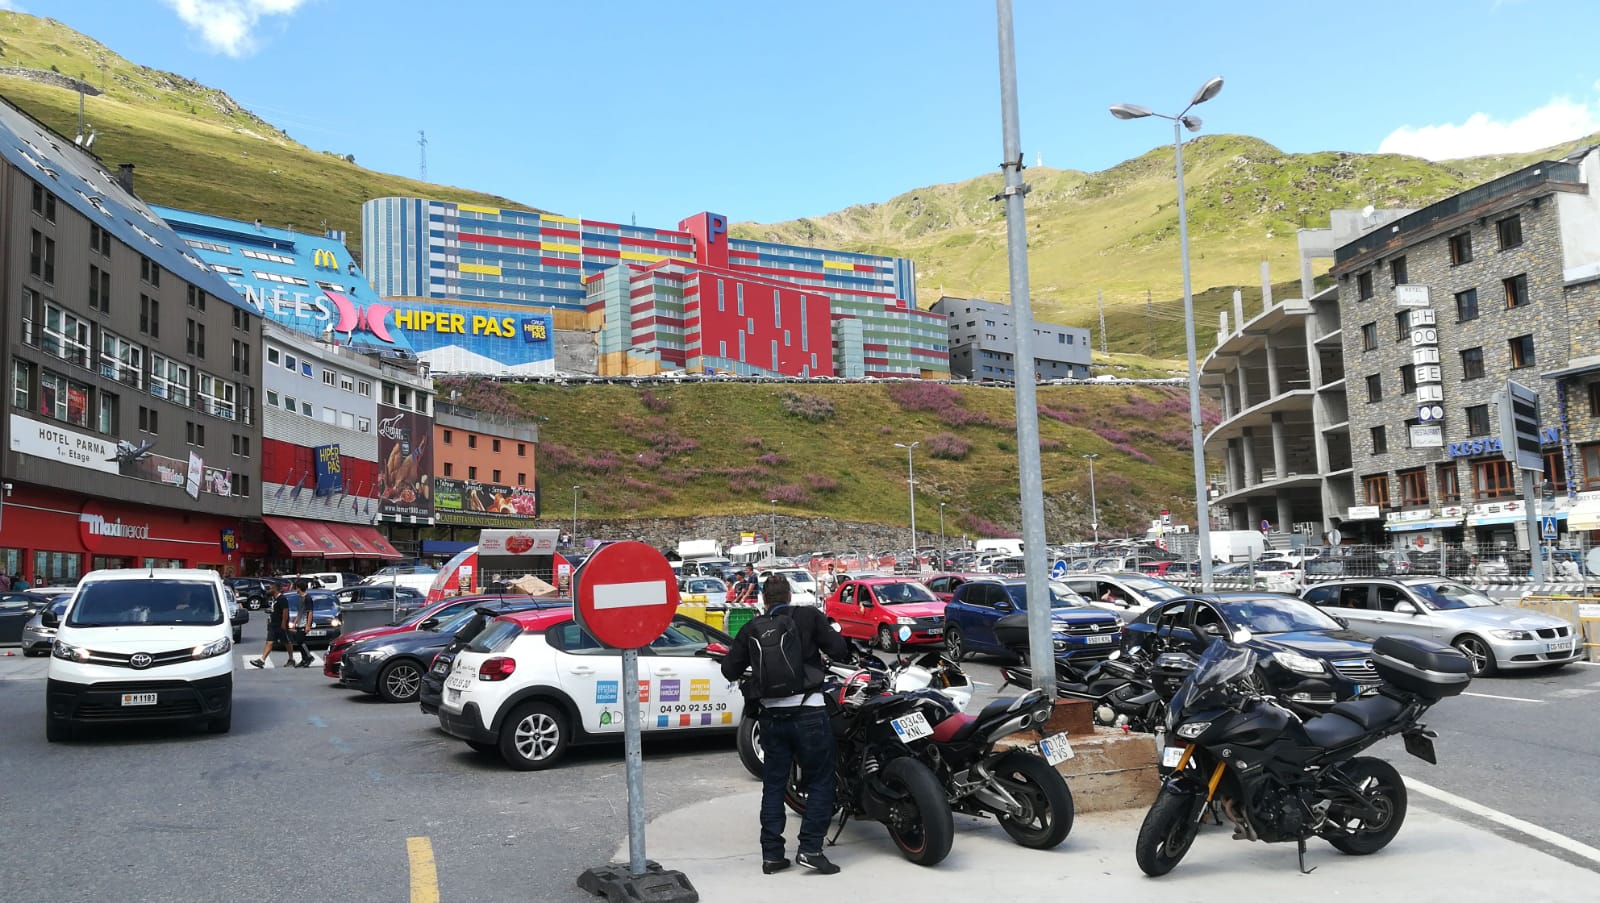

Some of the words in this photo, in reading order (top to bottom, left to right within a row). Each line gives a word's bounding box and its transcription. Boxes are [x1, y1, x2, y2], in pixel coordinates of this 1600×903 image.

[395, 309, 465, 334] HIPER
[473, 315, 516, 338] PAS
[39, 428, 69, 446] HOTEL
[77, 438, 105, 455] PARMA
[69, 449, 90, 462] Etage
[320, 447, 339, 462] HIPER
[328, 460, 340, 473] PAS
[660, 705, 672, 713] 04
[674, 704, 686, 713] 90
[688, 704, 699, 712] 92
[702, 703, 713, 711] 55
[716, 702, 727, 711] 30
[900, 713, 924, 728] 0349
[905, 725, 926, 739] KNL
